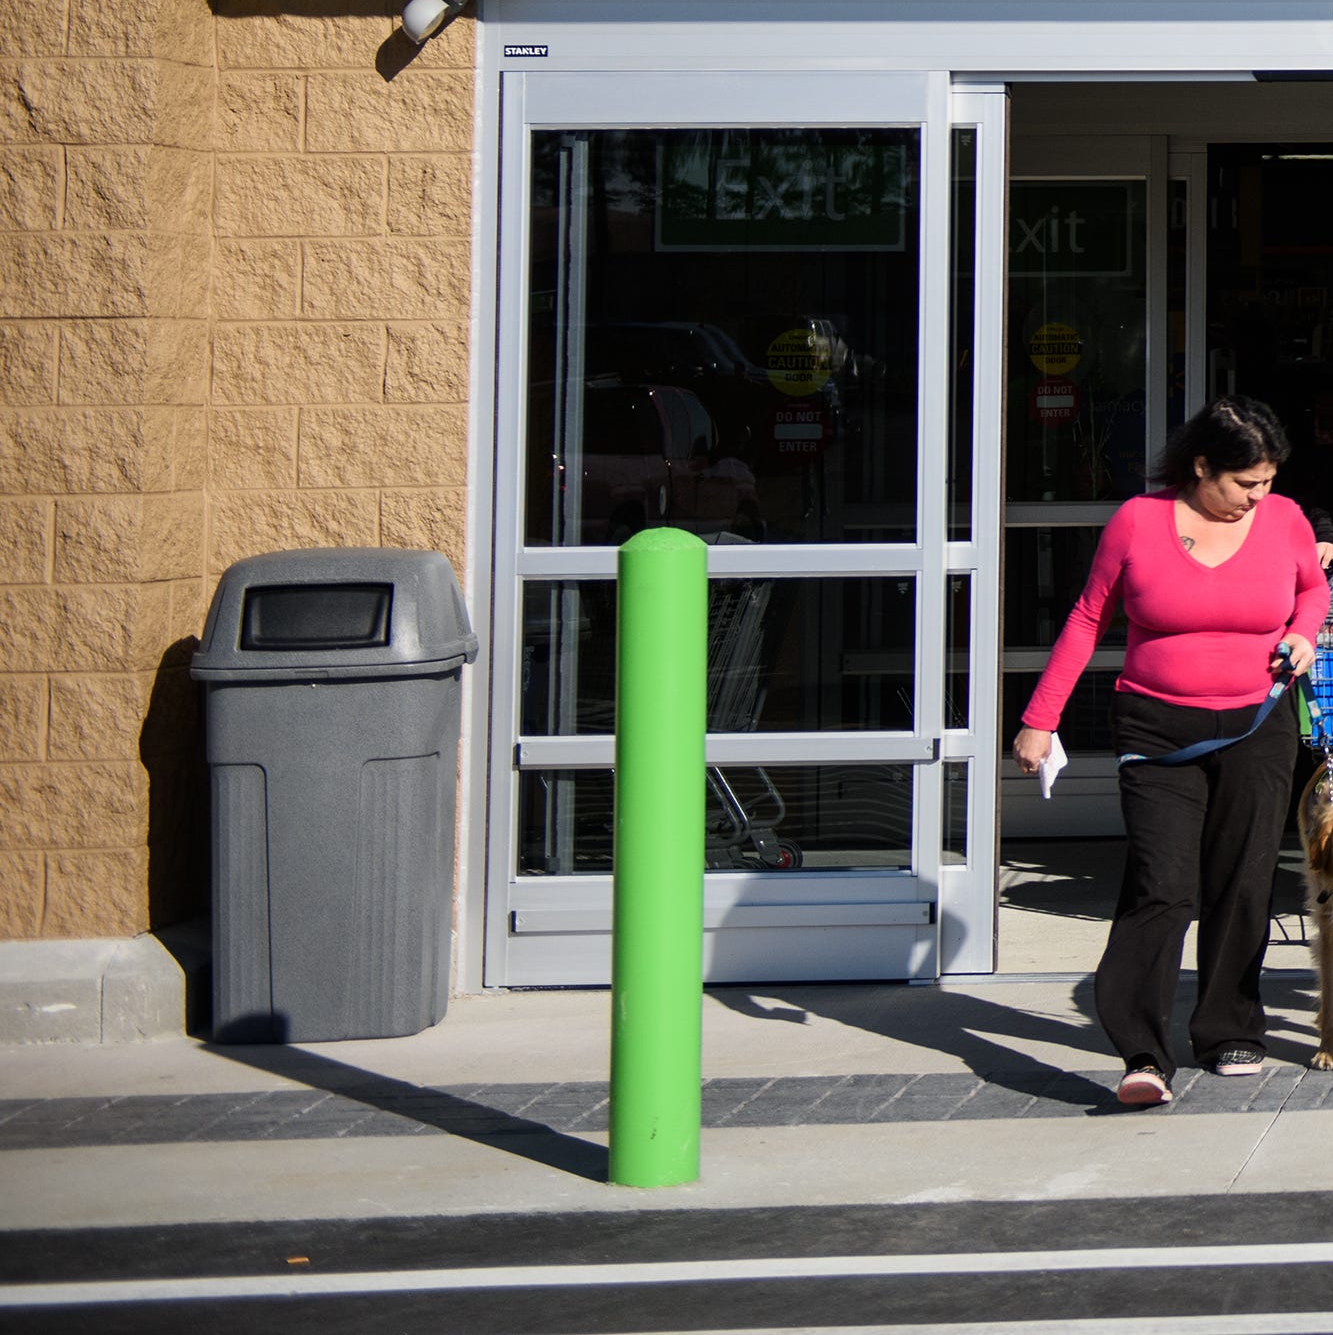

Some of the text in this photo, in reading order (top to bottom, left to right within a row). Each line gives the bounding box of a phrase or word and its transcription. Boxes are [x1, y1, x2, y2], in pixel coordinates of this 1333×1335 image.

[505, 47, 547, 55] STANLEY
[715, 158, 847, 221] Exit
[1009, 205, 1086, 253] xit
[1031, 344, 1079, 354] CAUTION
[768, 356, 829, 369] CAUTION
[1037, 386, 1073, 395] DO NOT
[776, 411, 822, 422] DO NOT
[1040, 409, 1071, 417] ENTER
[779, 441, 816, 453] ENTER
